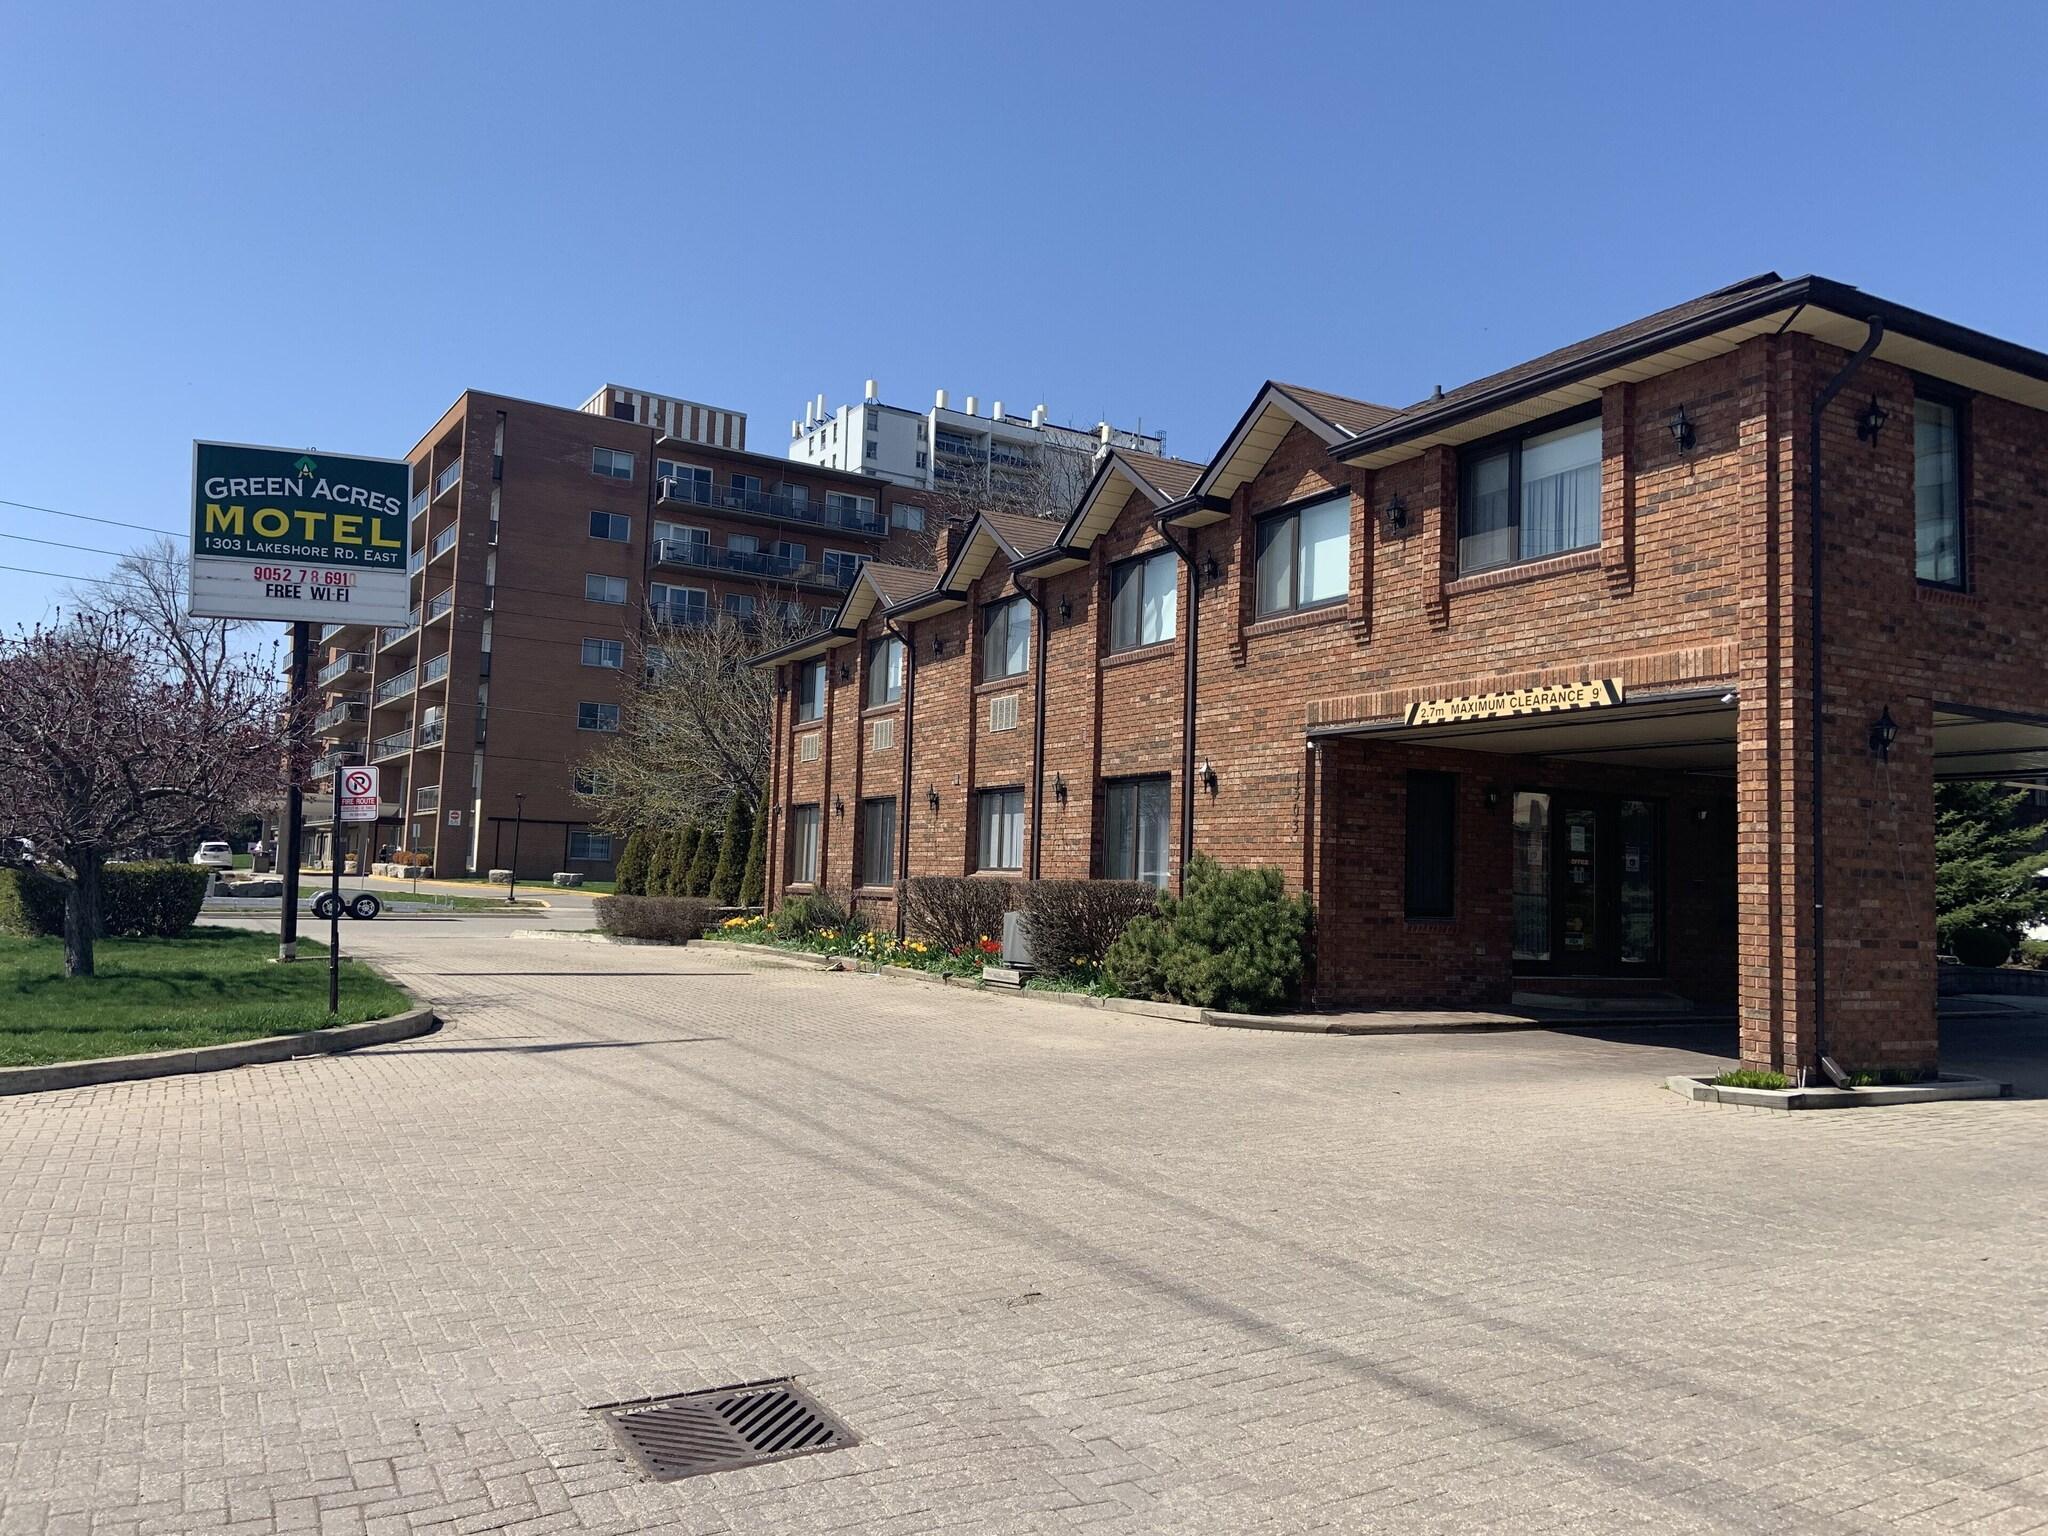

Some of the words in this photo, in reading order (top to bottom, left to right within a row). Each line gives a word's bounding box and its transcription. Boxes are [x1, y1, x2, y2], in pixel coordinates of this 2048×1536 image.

[204, 477, 304, 499] GREEN
[311, 478, 402, 516] ACRES
[205, 503, 401, 548] MOTEL
[205, 537, 241, 549] 1303
[246, 540, 329, 558] LAKESHORE
[334, 547, 358, 560] RD.
[364, 550, 398, 563] EAST
[254, 566, 291, 581] 9052
[265, 583, 302, 599] FREE
[310, 586, 350, 602] WI-FI
[1420, 707, 1444, 719] 2.7m
[1451, 698, 1505, 715] MAXIMUM
[1509, 689, 1584, 708] CLEARANCE
